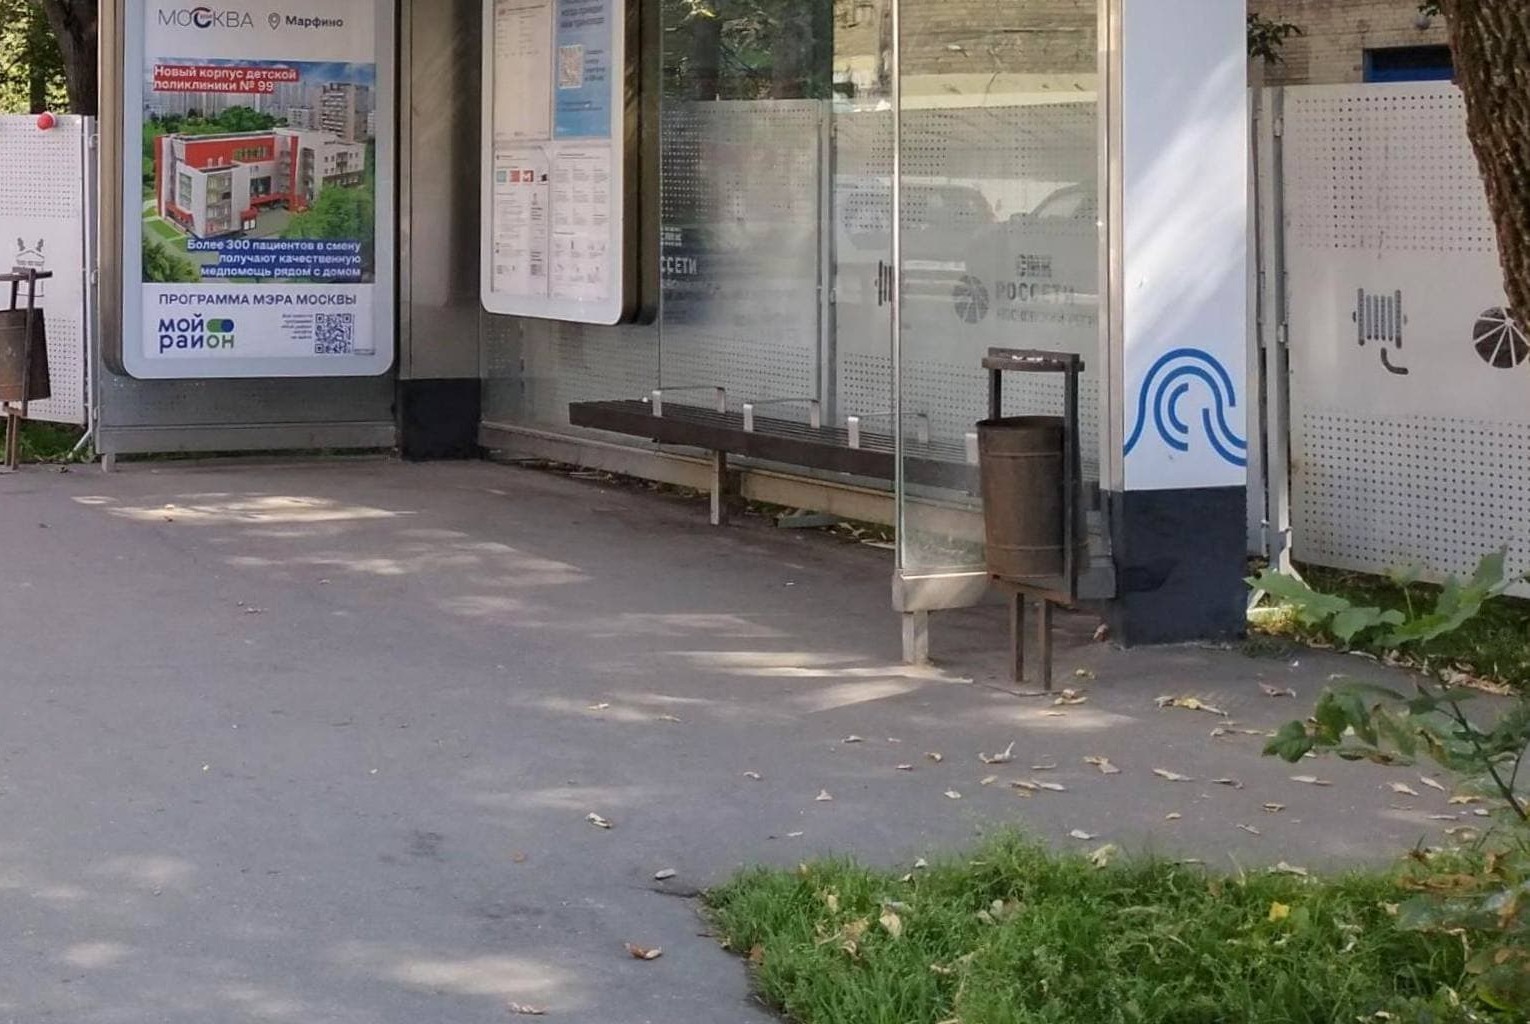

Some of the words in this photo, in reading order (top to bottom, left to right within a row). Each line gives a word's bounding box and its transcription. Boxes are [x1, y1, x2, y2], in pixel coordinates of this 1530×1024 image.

[158, 6, 254, 29] МОСКВА
[285, 15, 344, 31] Марфино
[154, 65, 198, 78] Новый
[199, 68, 244, 81] корпус
[246, 68, 297, 82] детской
[154, 80, 237, 92] поликлиники
[257, 81, 274, 92] 99
[187, 239, 224, 250] Более
[226, 239, 250, 251] 300
[252, 240, 315, 252] пациентов
[316, 242, 324, 251] в
[326, 242, 362, 253] смену
[219, 254, 276, 266] получают
[279, 254, 362, 266] качественную
[201, 267, 271, 278] медпомощь
[274, 267, 311, 278] рядом
[314, 268, 321, 277] с
[322, 267, 362, 278] домом
[159, 293, 248, 305] ПРОГРАММА
[253, 294, 293, 306] МЭРА
[296, 294, 357, 306] МОСКВЫ
[158, 313, 205, 333] мой
